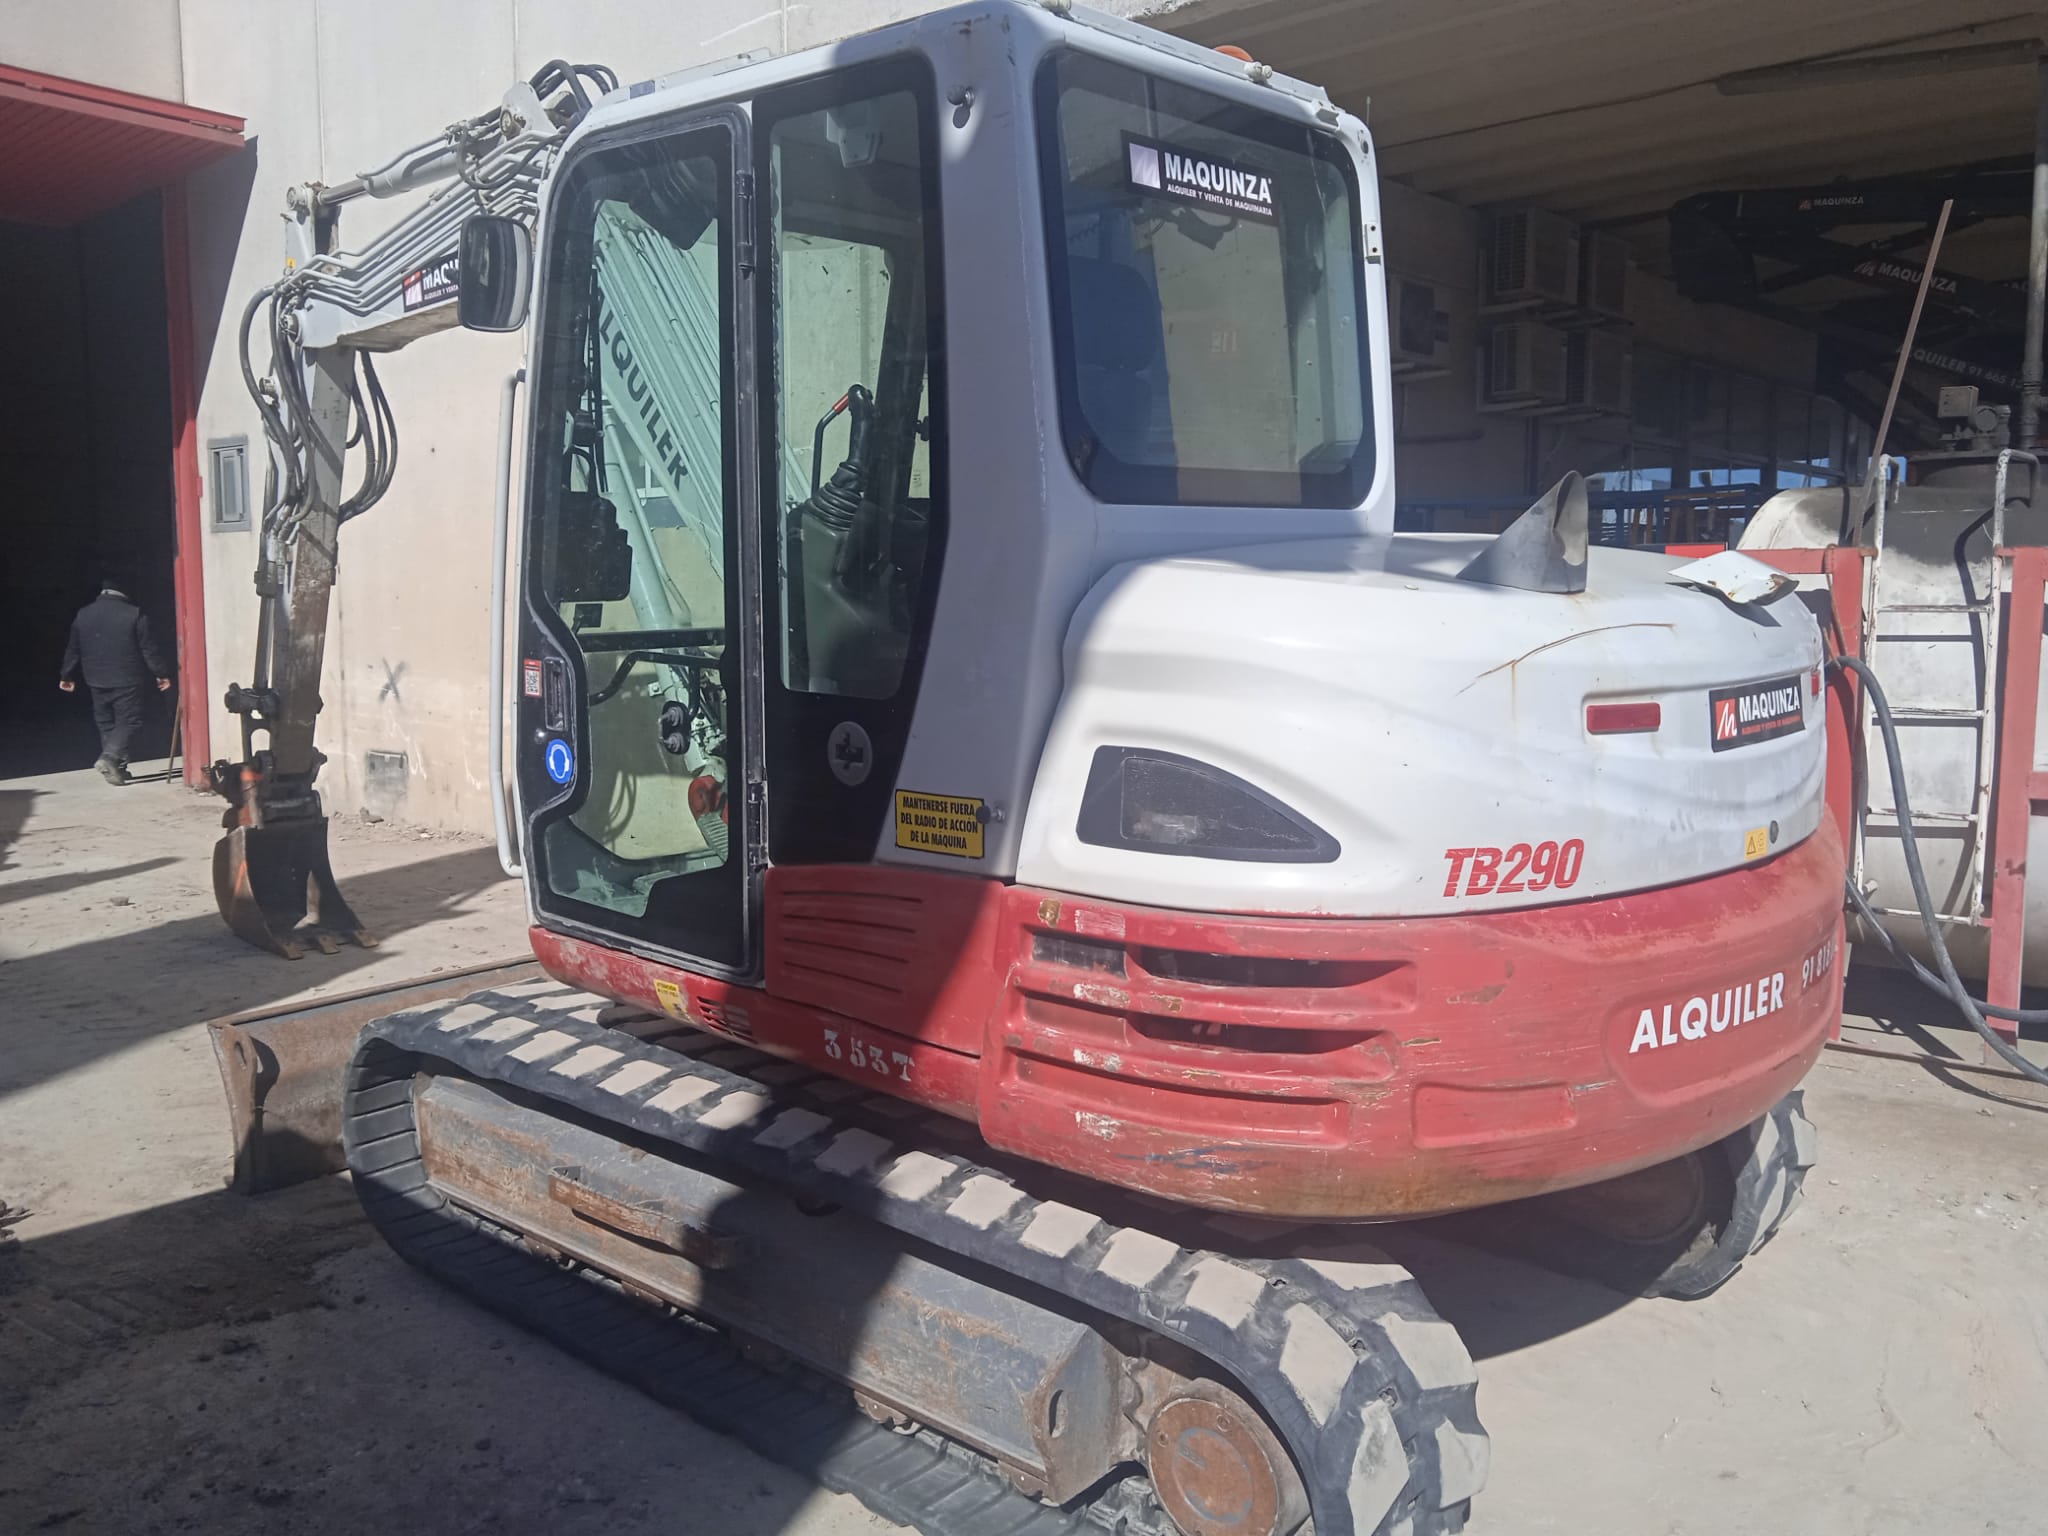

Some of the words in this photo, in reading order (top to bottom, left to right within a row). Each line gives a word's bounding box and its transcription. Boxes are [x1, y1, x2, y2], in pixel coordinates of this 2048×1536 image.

[1164, 151, 1272, 204] MAQUINZA
[1167, 184, 1196, 198] ALQUILER
[1198, 191, 1203, 200] Y
[1204, 193, 1224, 206] VENTA
[1225, 197, 1233, 207] DE
[1234, 200, 1273, 216] MAQUINARIA
[1879, 262, 1957, 293] MAQUNZA
[1738, 685, 1801, 723] MAQUINZA
[903, 796, 948, 812] MANTENERSE
[950, 802, 975, 815] FUERA
[900, 812, 913, 825] DEL
[914, 814, 936, 828] RADIO
[938, 818, 948, 830] DE
[950, 817, 978, 833] ACCIÓN
[910, 830, 919, 843] DE
[920, 832, 929, 843] LA
[931, 830, 967, 849] MÁQUINA
[1443, 838, 1585, 897] TB290
[1628, 972, 1785, 1053] ALQUILER
[1802, 955, 1815, 989] 91
